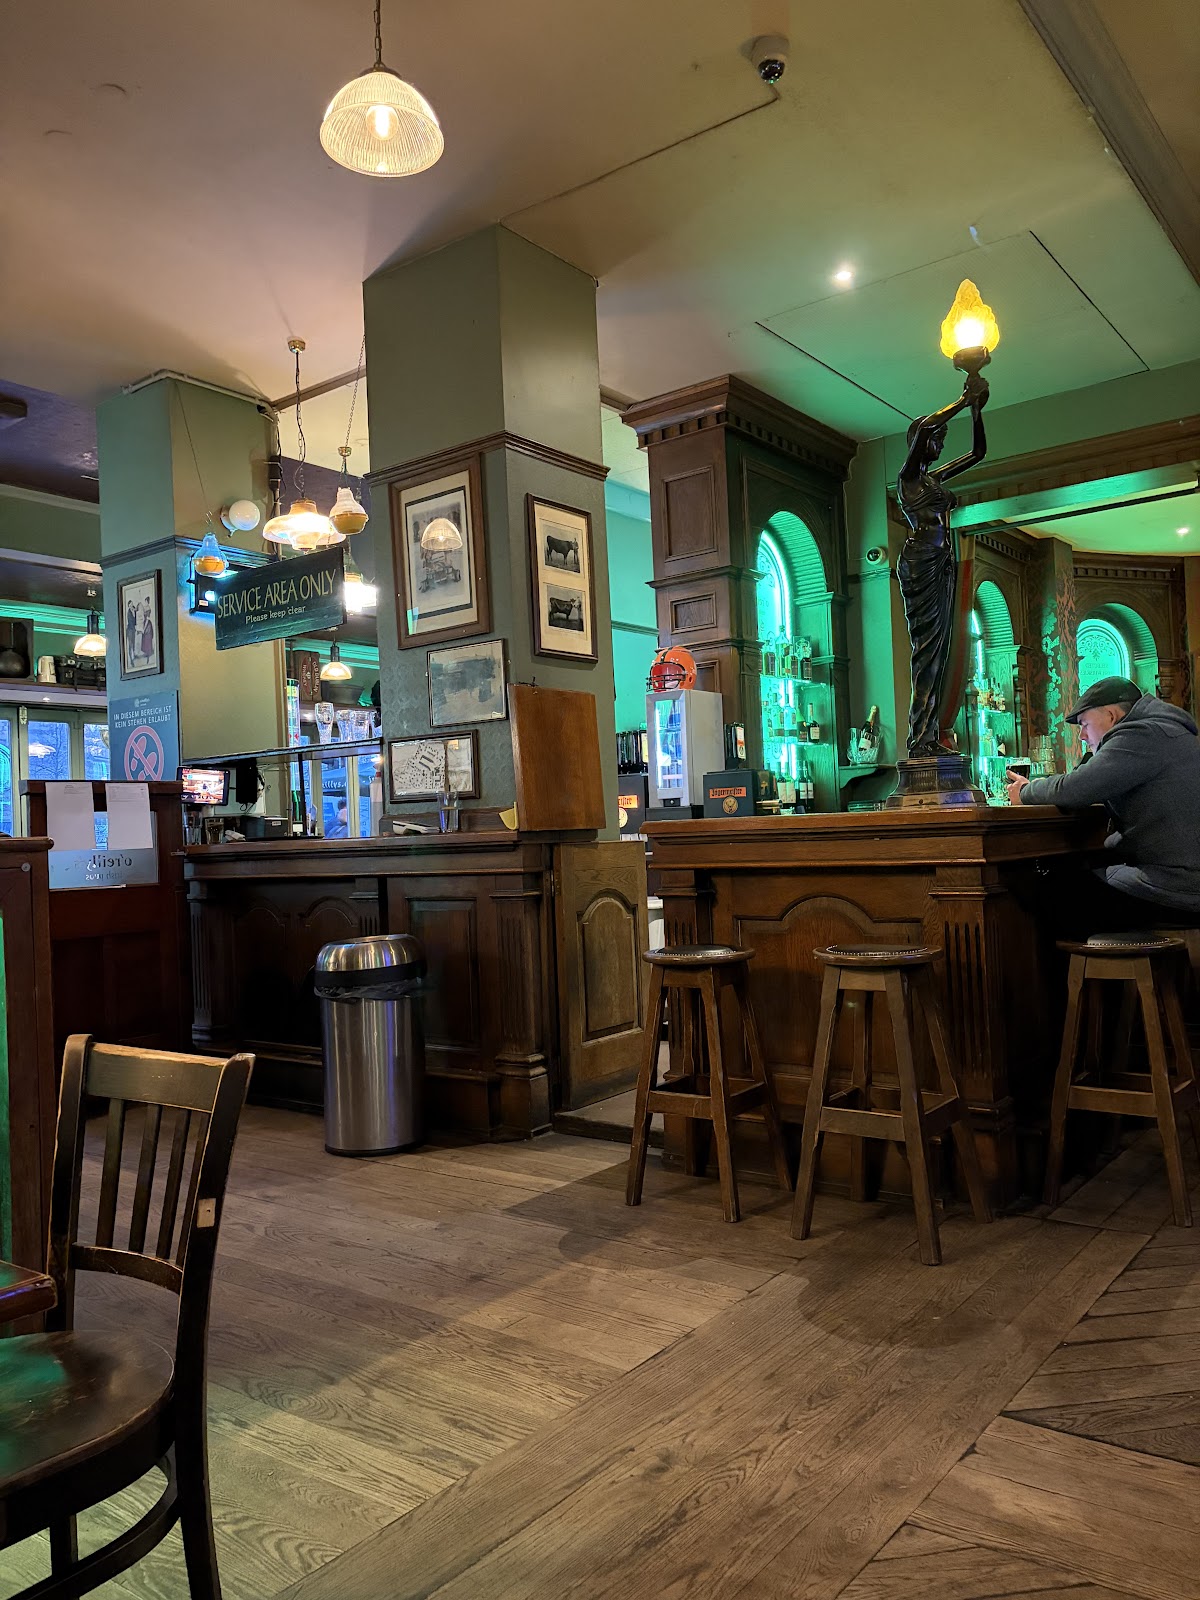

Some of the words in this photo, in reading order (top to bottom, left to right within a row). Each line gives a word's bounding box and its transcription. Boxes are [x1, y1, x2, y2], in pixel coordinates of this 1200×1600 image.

[217, 586, 262, 619] SERVICE
[263, 578, 299, 608] AREA
[299, 568, 337, 600] ONLY
[245, 613, 268, 624] Please
[269, 609, 286, 619] keep
[287, 605, 306, 615] clear
[113, 713, 120, 721] IN
[120, 711, 140, 720] DIESEM
[140, 707, 163, 717] BEREICH
[163, 705, 172, 713] IST
[127, 718, 147, 727] STEHEN
[148, 714, 171, 724] ERLAUBT
